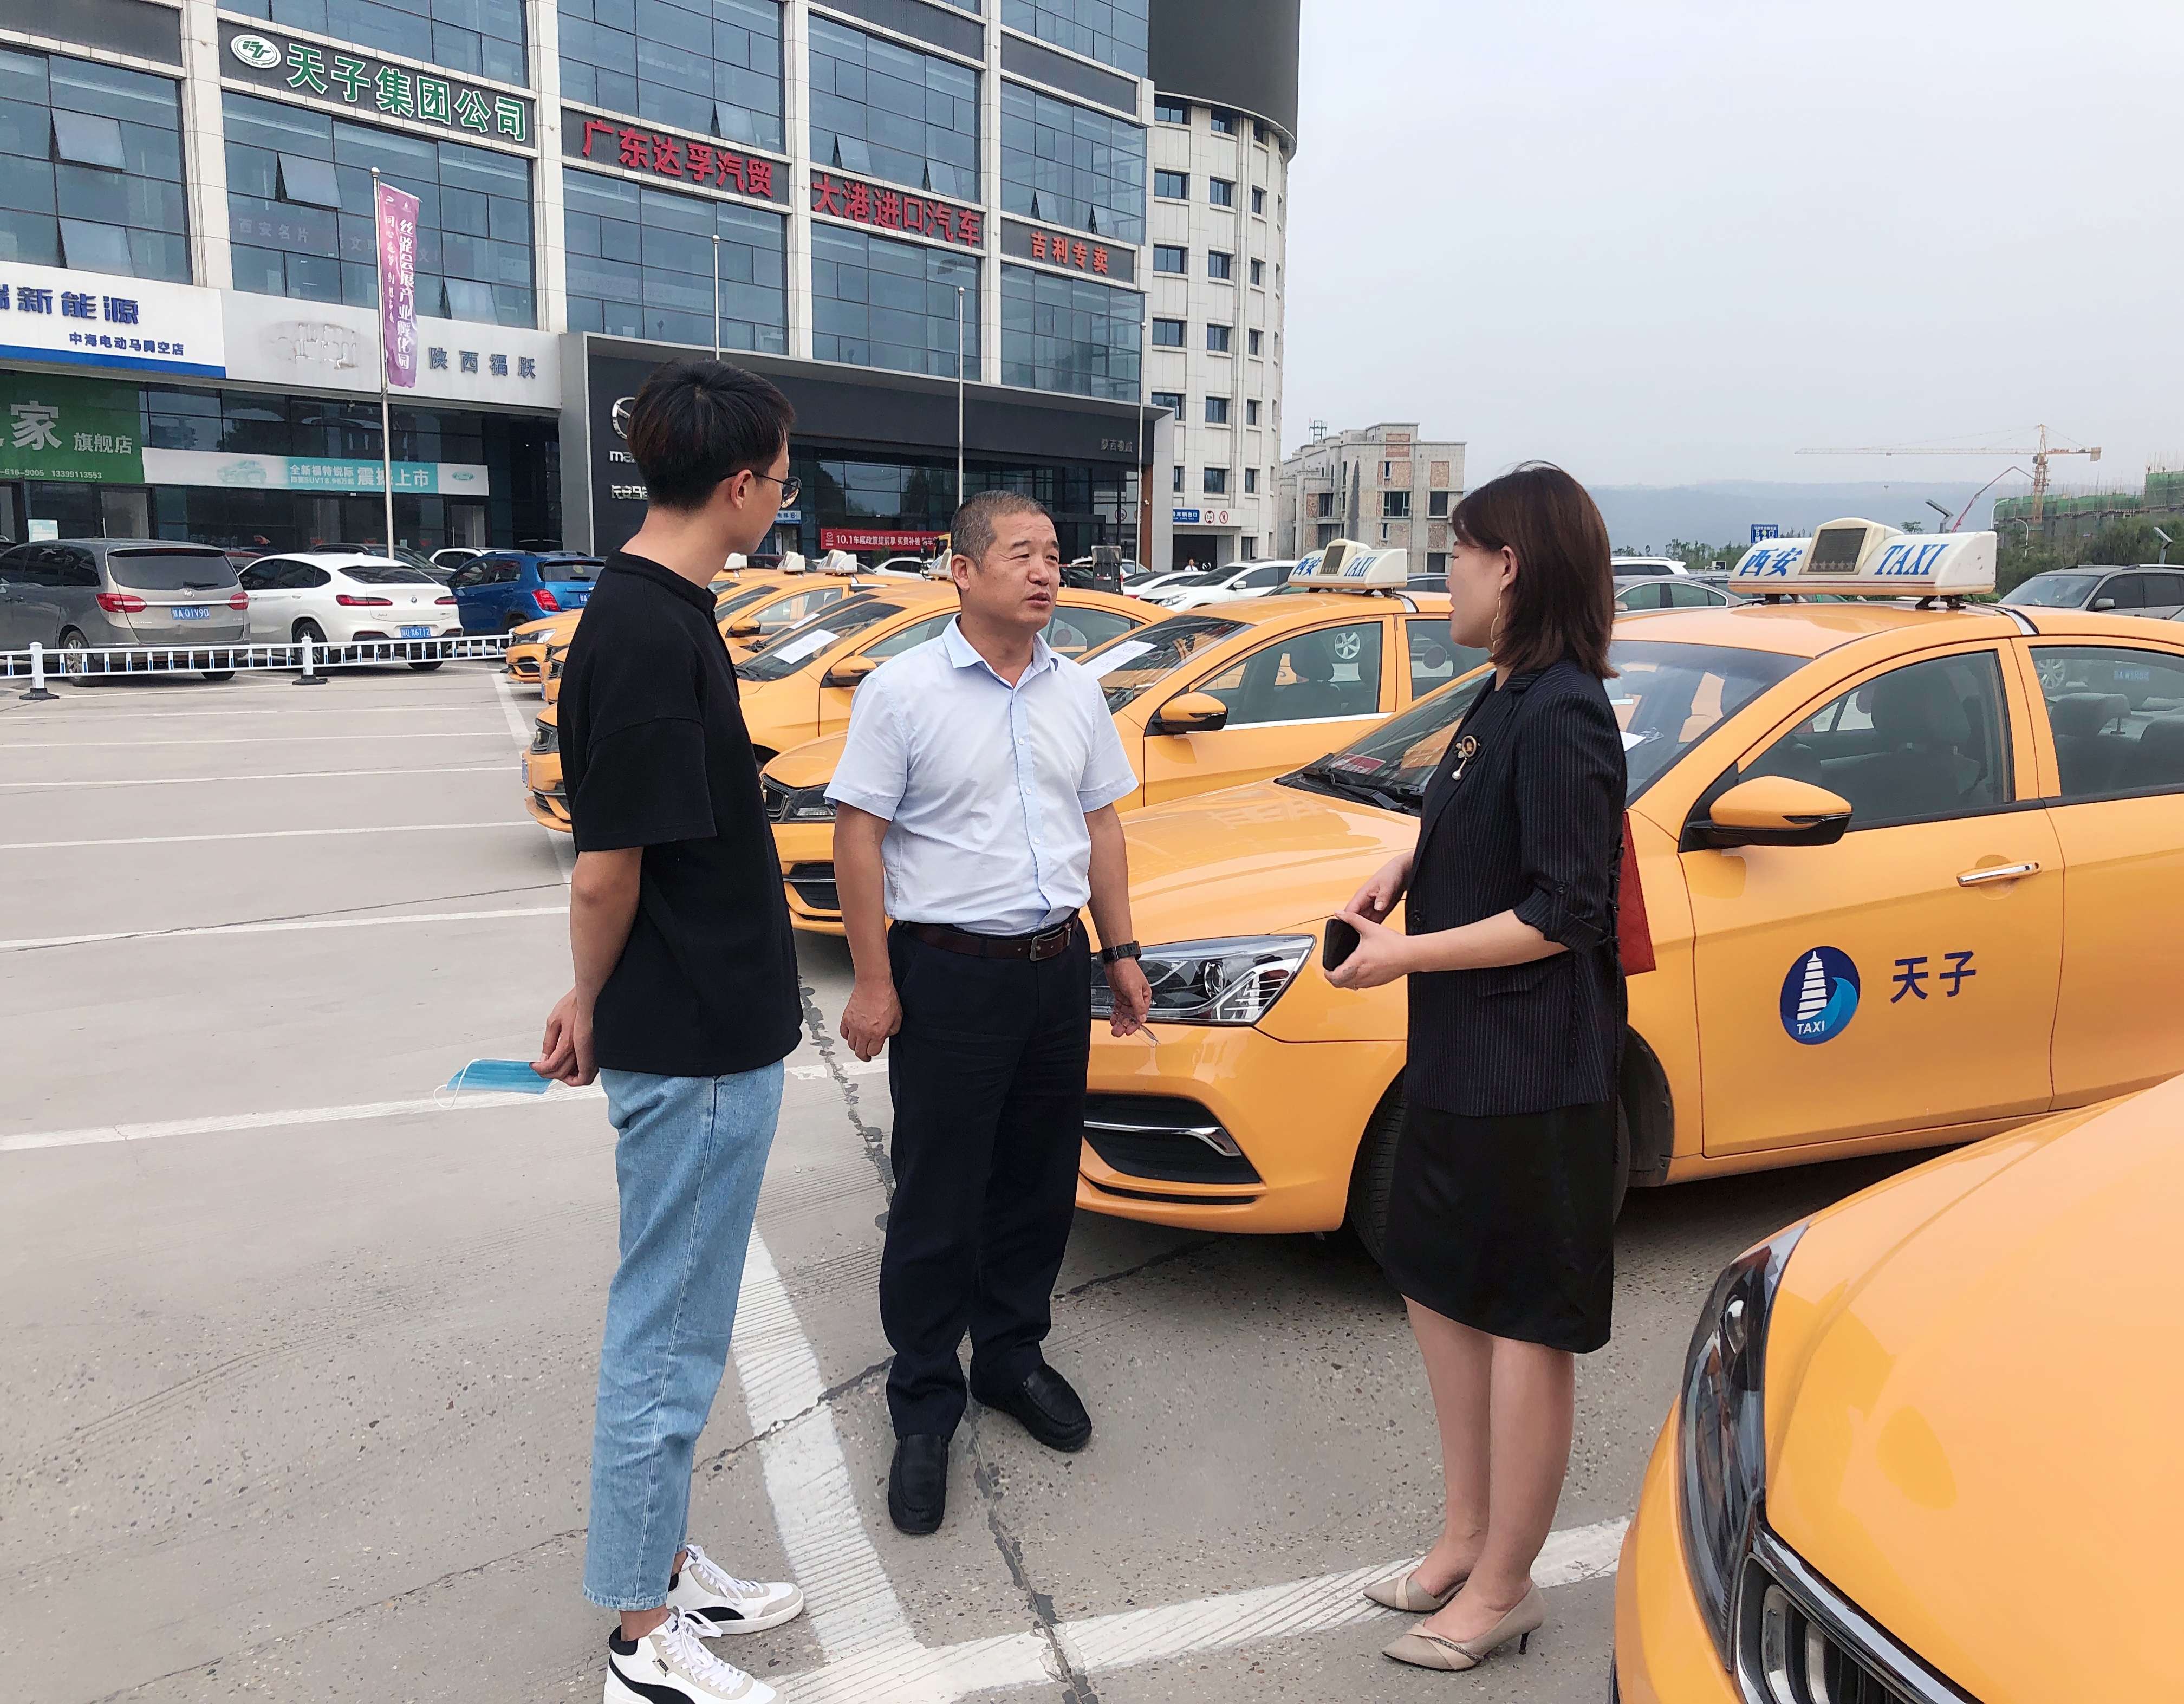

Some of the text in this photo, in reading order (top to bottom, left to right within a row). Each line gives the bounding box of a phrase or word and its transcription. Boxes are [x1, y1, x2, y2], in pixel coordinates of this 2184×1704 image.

[285, 43, 525, 141] 天子集团公司
[582, 120, 773, 197] 广东达孚汽贸
[812, 173, 981, 247] 大港进口汽车
[1031, 231, 1109, 274] 吉利专卖
[428, 347, 536, 379] 陕西福跃
[0, 400, 63, 450] 家
[74, 432, 132, 454] 旗舰店
[610, 451, 636, 463] ma
[52, 470, 102, 479] 13399113553
[1292, 557, 1322, 576] 西安
[1738, 544, 1949, 577] 西安 TAXI
[1890, 951, 1977, 1004] 天子
[1796, 1020, 1825, 1035] TAXI
